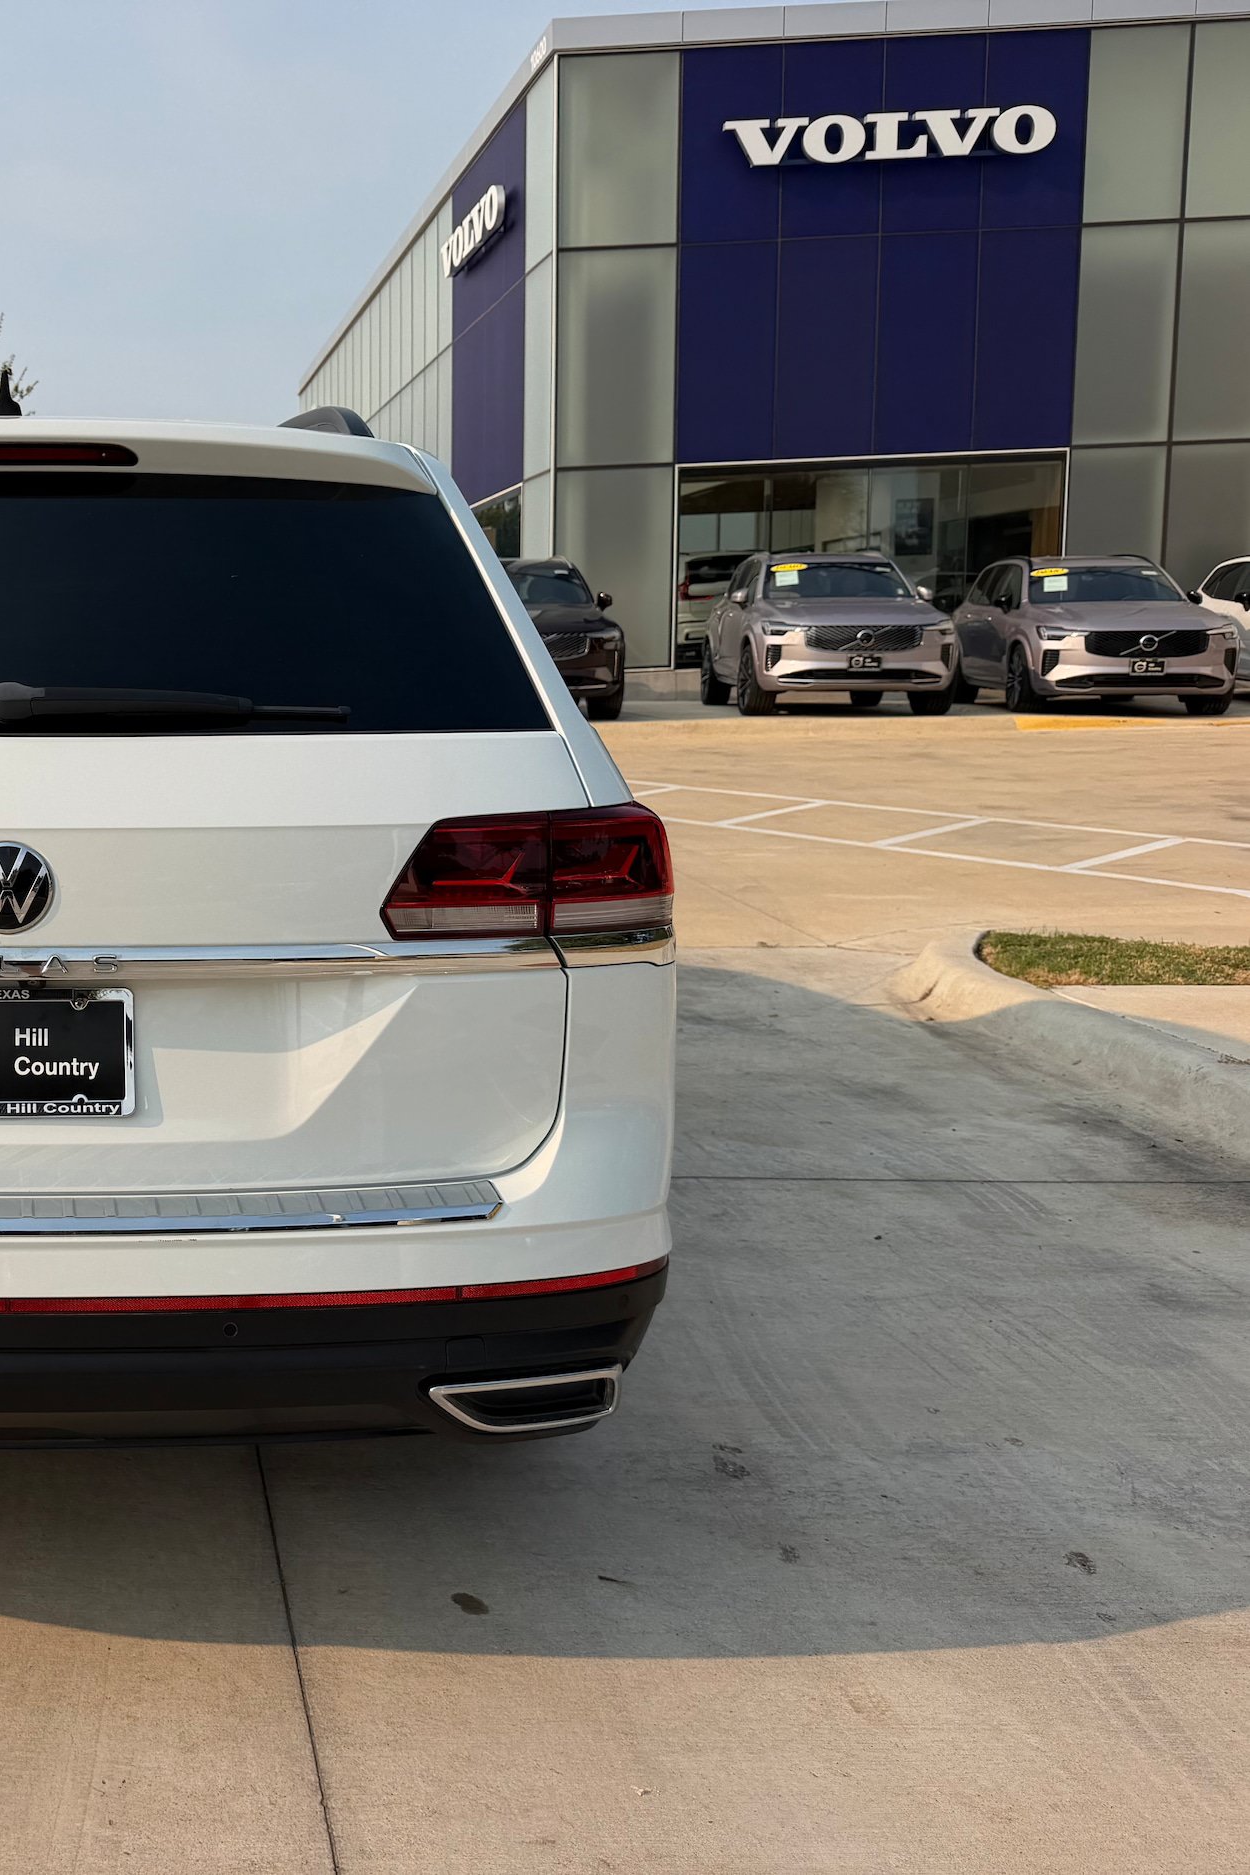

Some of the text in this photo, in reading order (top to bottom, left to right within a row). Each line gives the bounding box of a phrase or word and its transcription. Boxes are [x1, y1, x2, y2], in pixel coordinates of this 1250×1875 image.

[723, 104, 1057, 168] VOLVO
[441, 184, 505, 278] VOLVO
[14, 1028, 49, 1047] Hill
[14, 1056, 100, 1080] Country
[6, 1102, 37, 1115] Hill
[43, 1102, 121, 1116] Country
